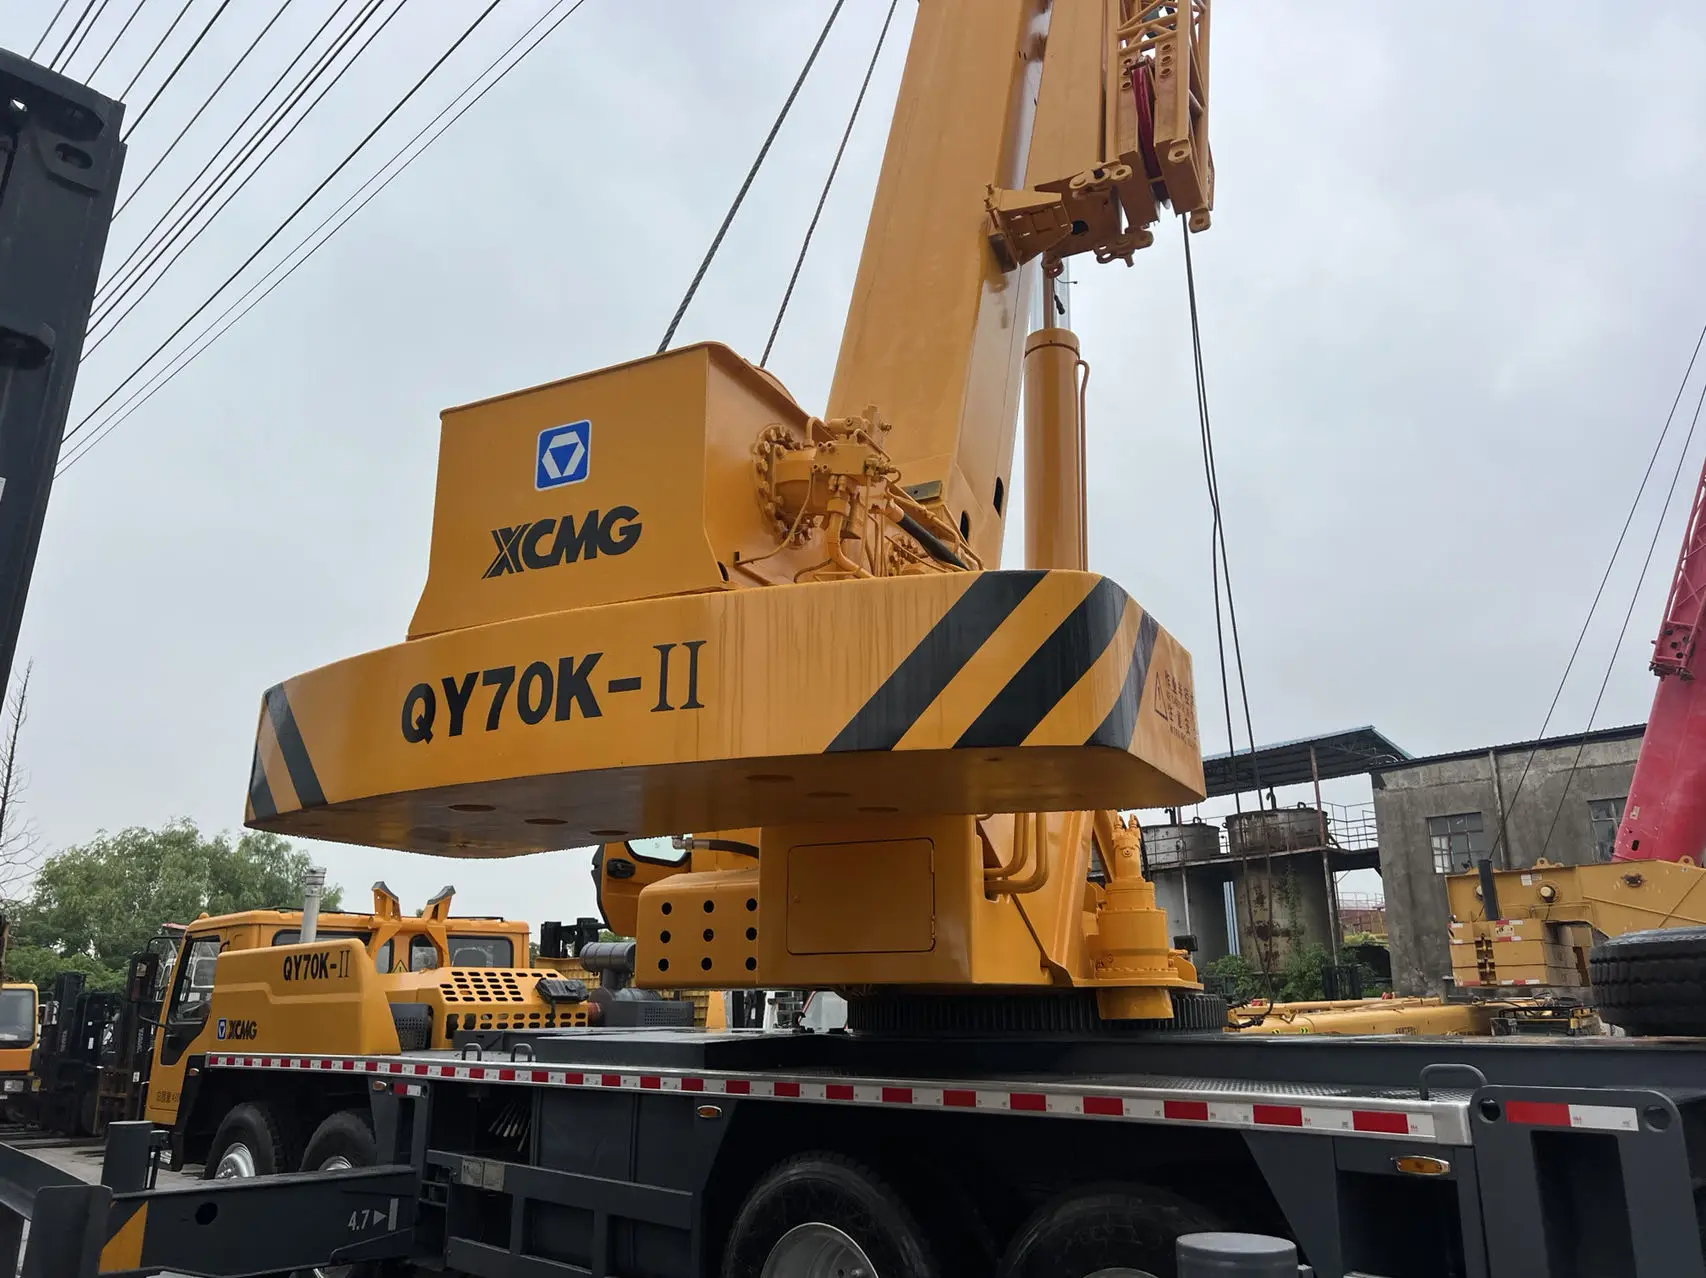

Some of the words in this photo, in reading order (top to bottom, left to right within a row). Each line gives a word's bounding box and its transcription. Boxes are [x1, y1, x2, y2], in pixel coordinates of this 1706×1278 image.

[481, 505, 643, 580] XCMG
[228, 1020, 257, 1040] XCMG
[348, 1209, 370, 1231] 4.7
